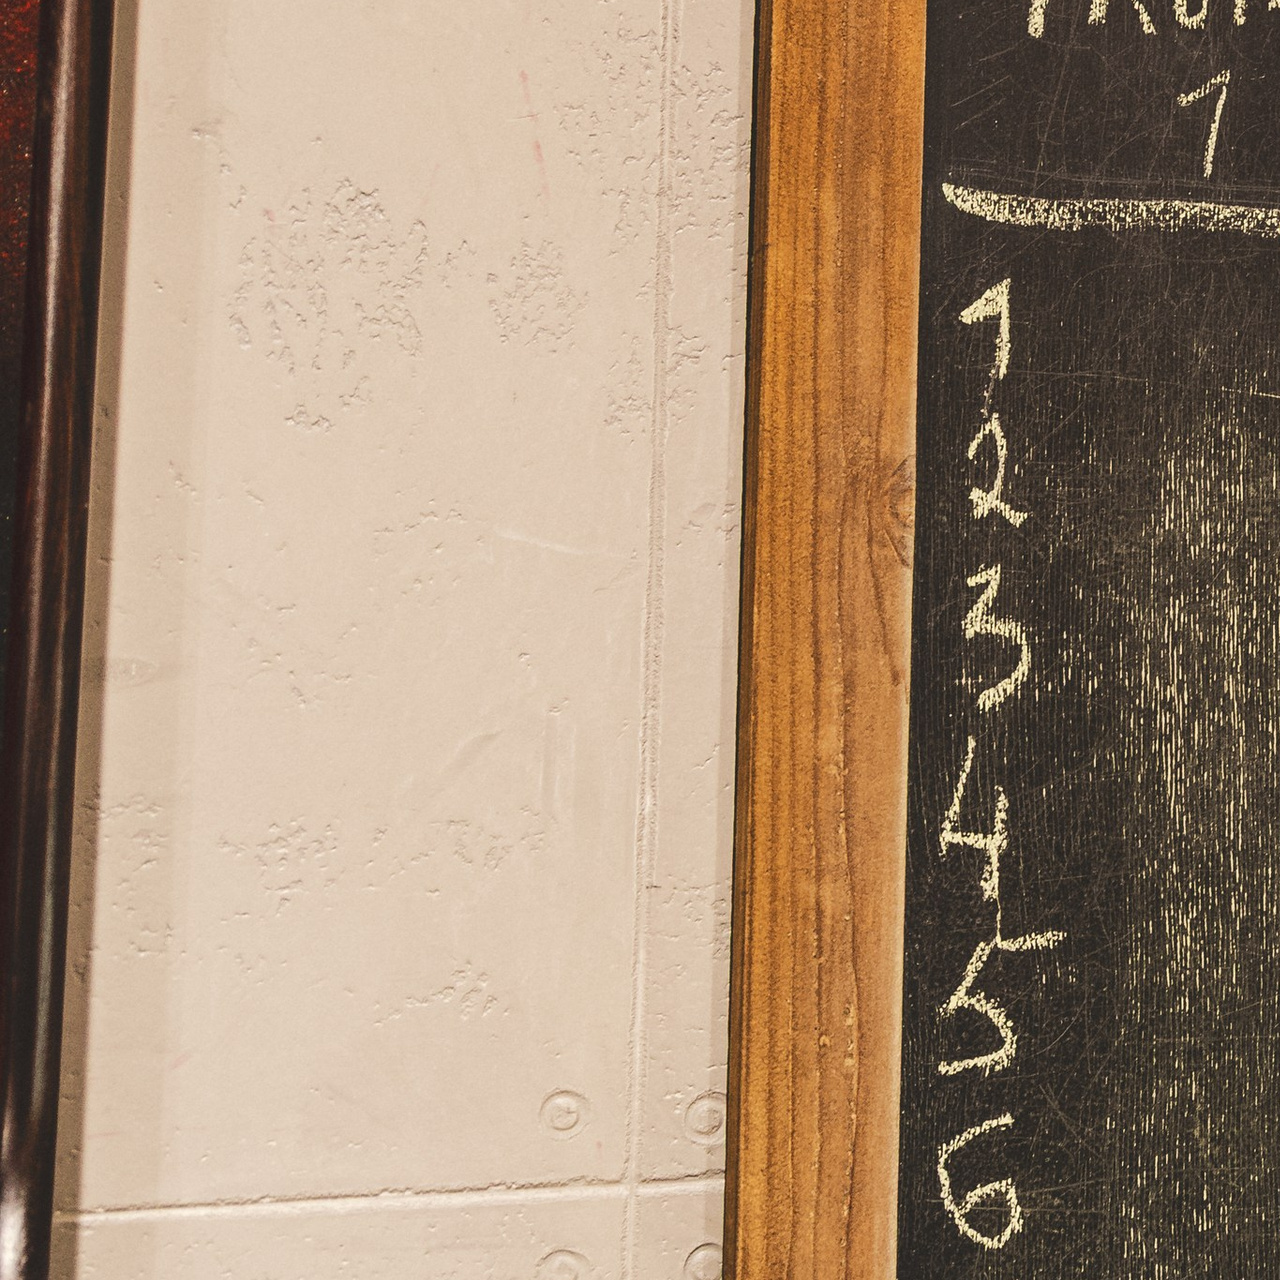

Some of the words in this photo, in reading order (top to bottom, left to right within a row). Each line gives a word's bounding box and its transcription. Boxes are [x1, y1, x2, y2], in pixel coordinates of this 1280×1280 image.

[1176, 69, 1231, 179] 1
[958, 277, 1012, 402] 1
[967, 412, 1029, 527] 2
[964, 562, 1032, 712] 3
[938, 734, 1010, 903] 4
[938, 931, 1068, 1078] 5
[937, 1113, 1024, 1251] 6
